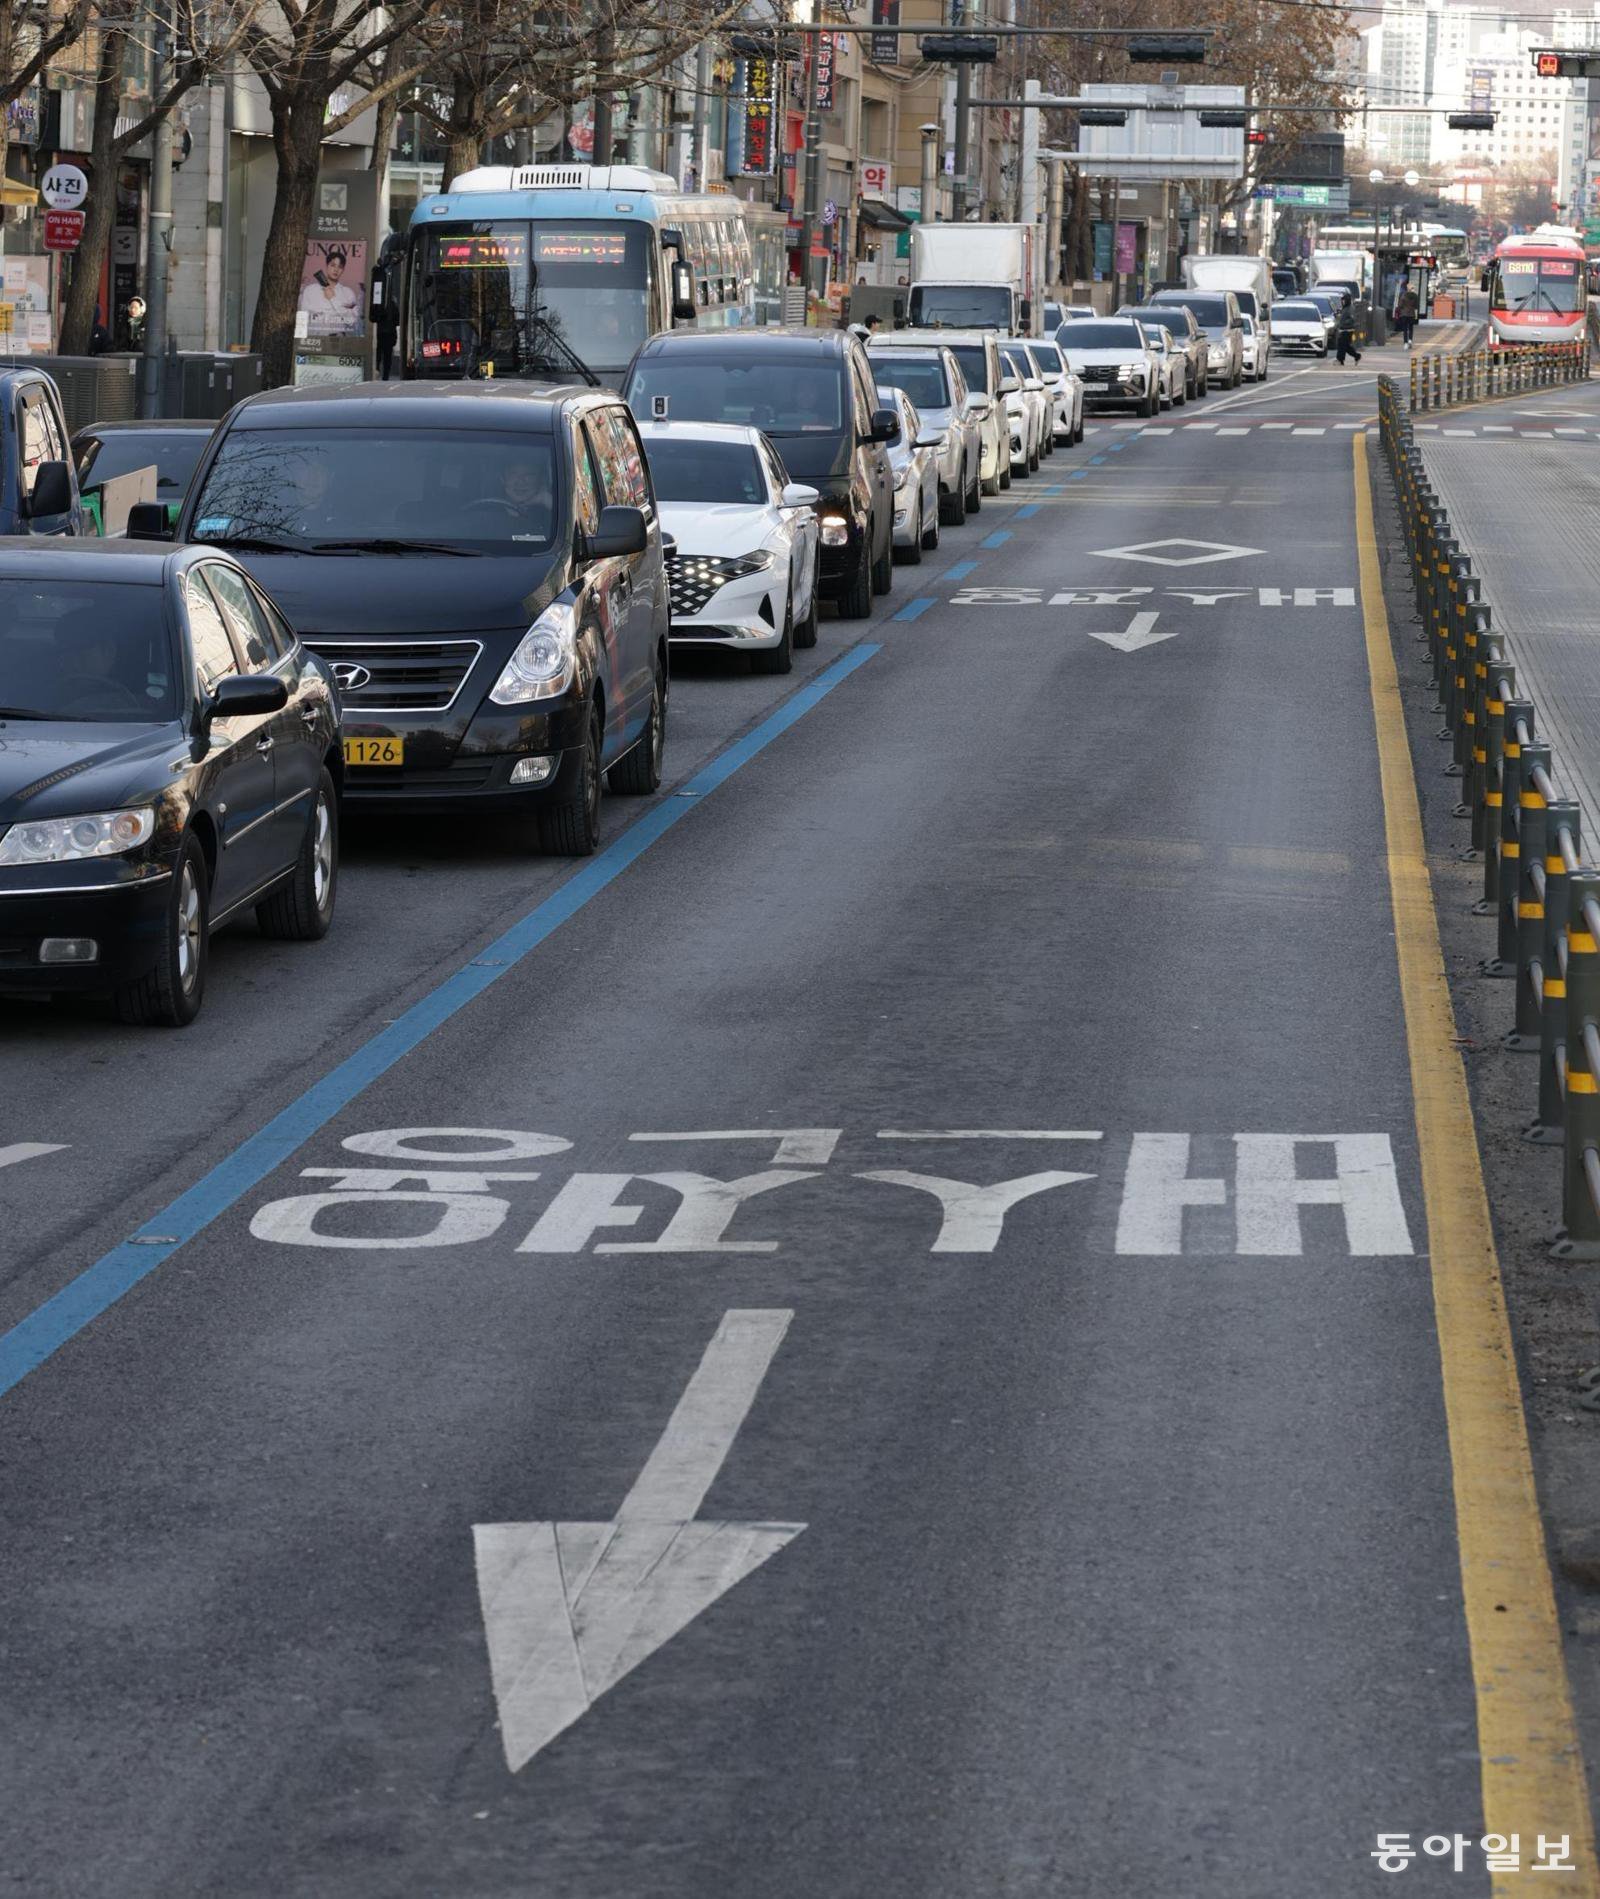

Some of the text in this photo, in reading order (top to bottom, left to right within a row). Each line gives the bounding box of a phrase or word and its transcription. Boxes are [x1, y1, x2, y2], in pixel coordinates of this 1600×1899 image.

[45, 177, 81, 195] 사진
[864, 167, 887, 191] 약
[47, 216, 81, 225] ON HAIR
[338, 356, 362, 367] 6002
[344, 742, 395, 762] 1126
